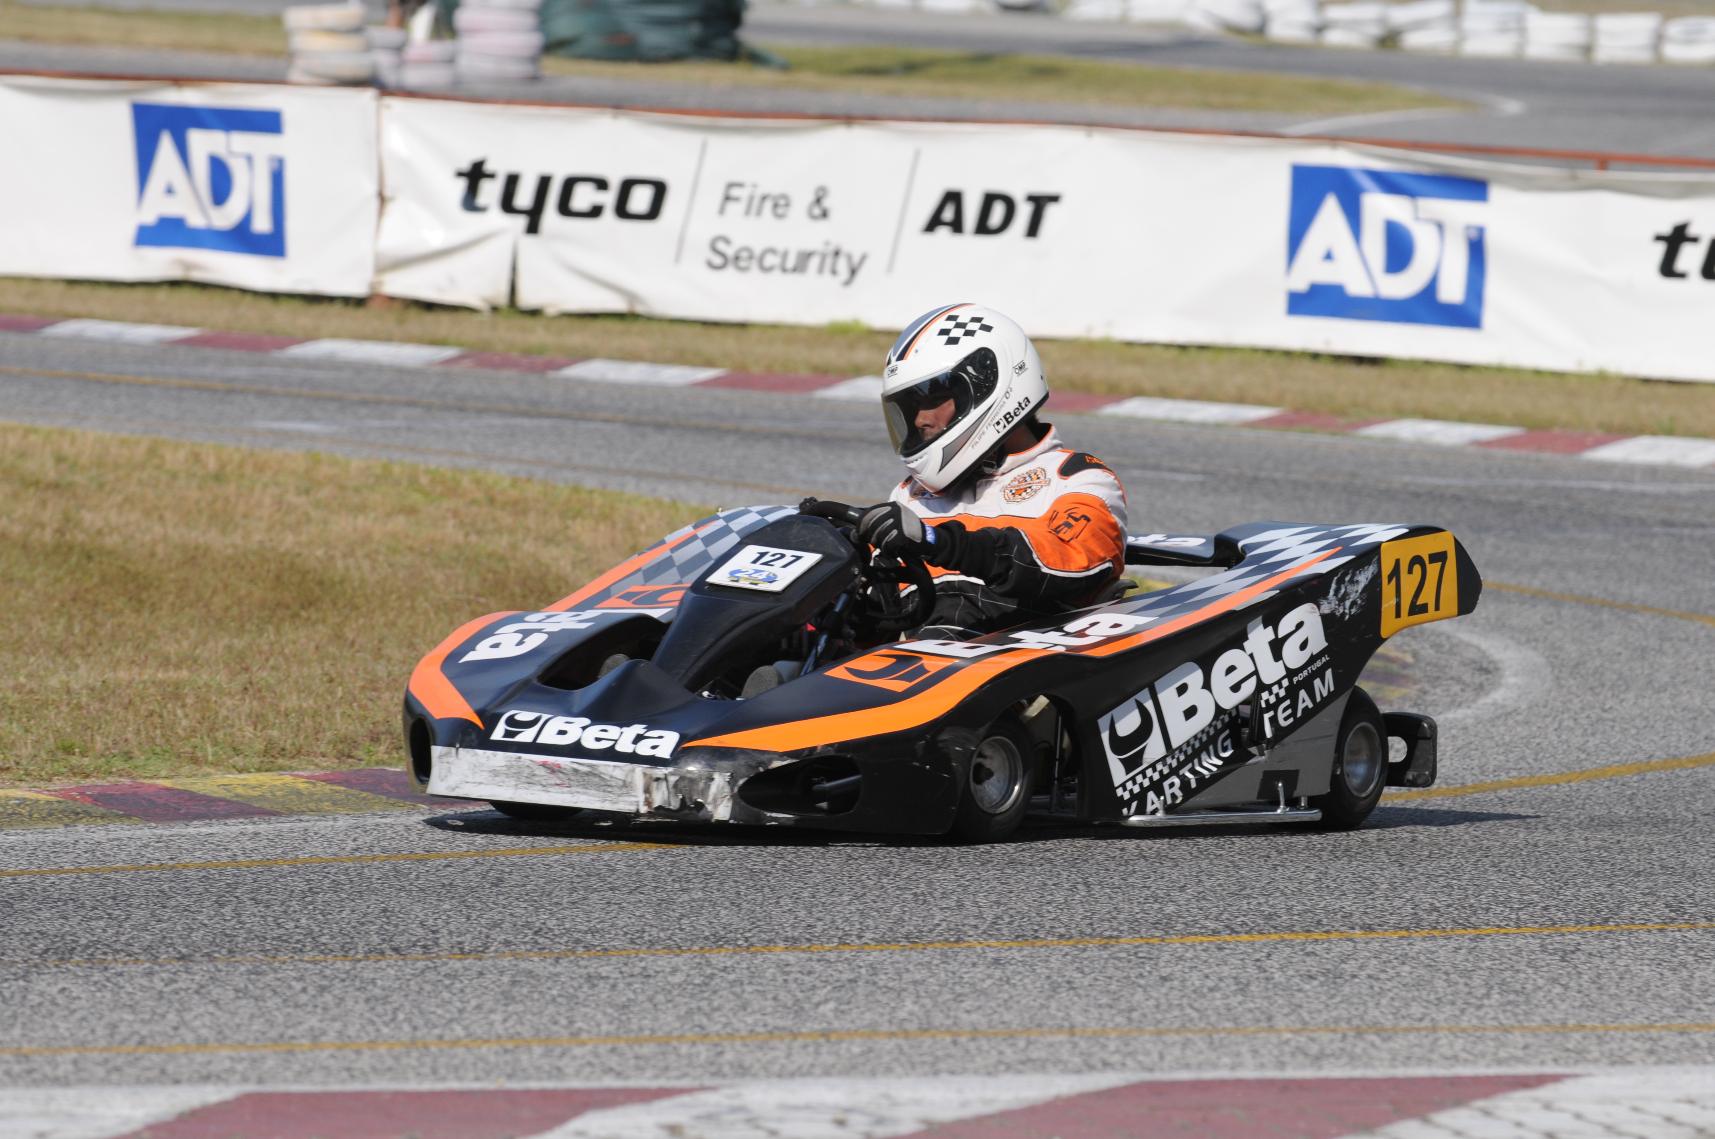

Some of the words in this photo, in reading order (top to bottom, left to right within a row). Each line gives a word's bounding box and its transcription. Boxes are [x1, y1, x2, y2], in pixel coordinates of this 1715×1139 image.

[137, 128, 284, 234] ADT
[455, 158, 667, 235] tyco
[718, 182, 791, 219] Fire
[807, 186, 831, 220] &
[923, 190, 1062, 238] ADT
[706, 236, 868, 286] Security
[1288, 192, 1488, 305] ADT
[1003, 396, 1031, 425] Beta
[750, 551, 804, 569] 127
[1386, 551, 1448, 619] 127
[1155, 602, 1329, 750] Beta
[1292, 654, 1331, 685] PORTUGAL
[1263, 667, 1335, 739] TEAM
[536, 716, 681, 759] Beta
